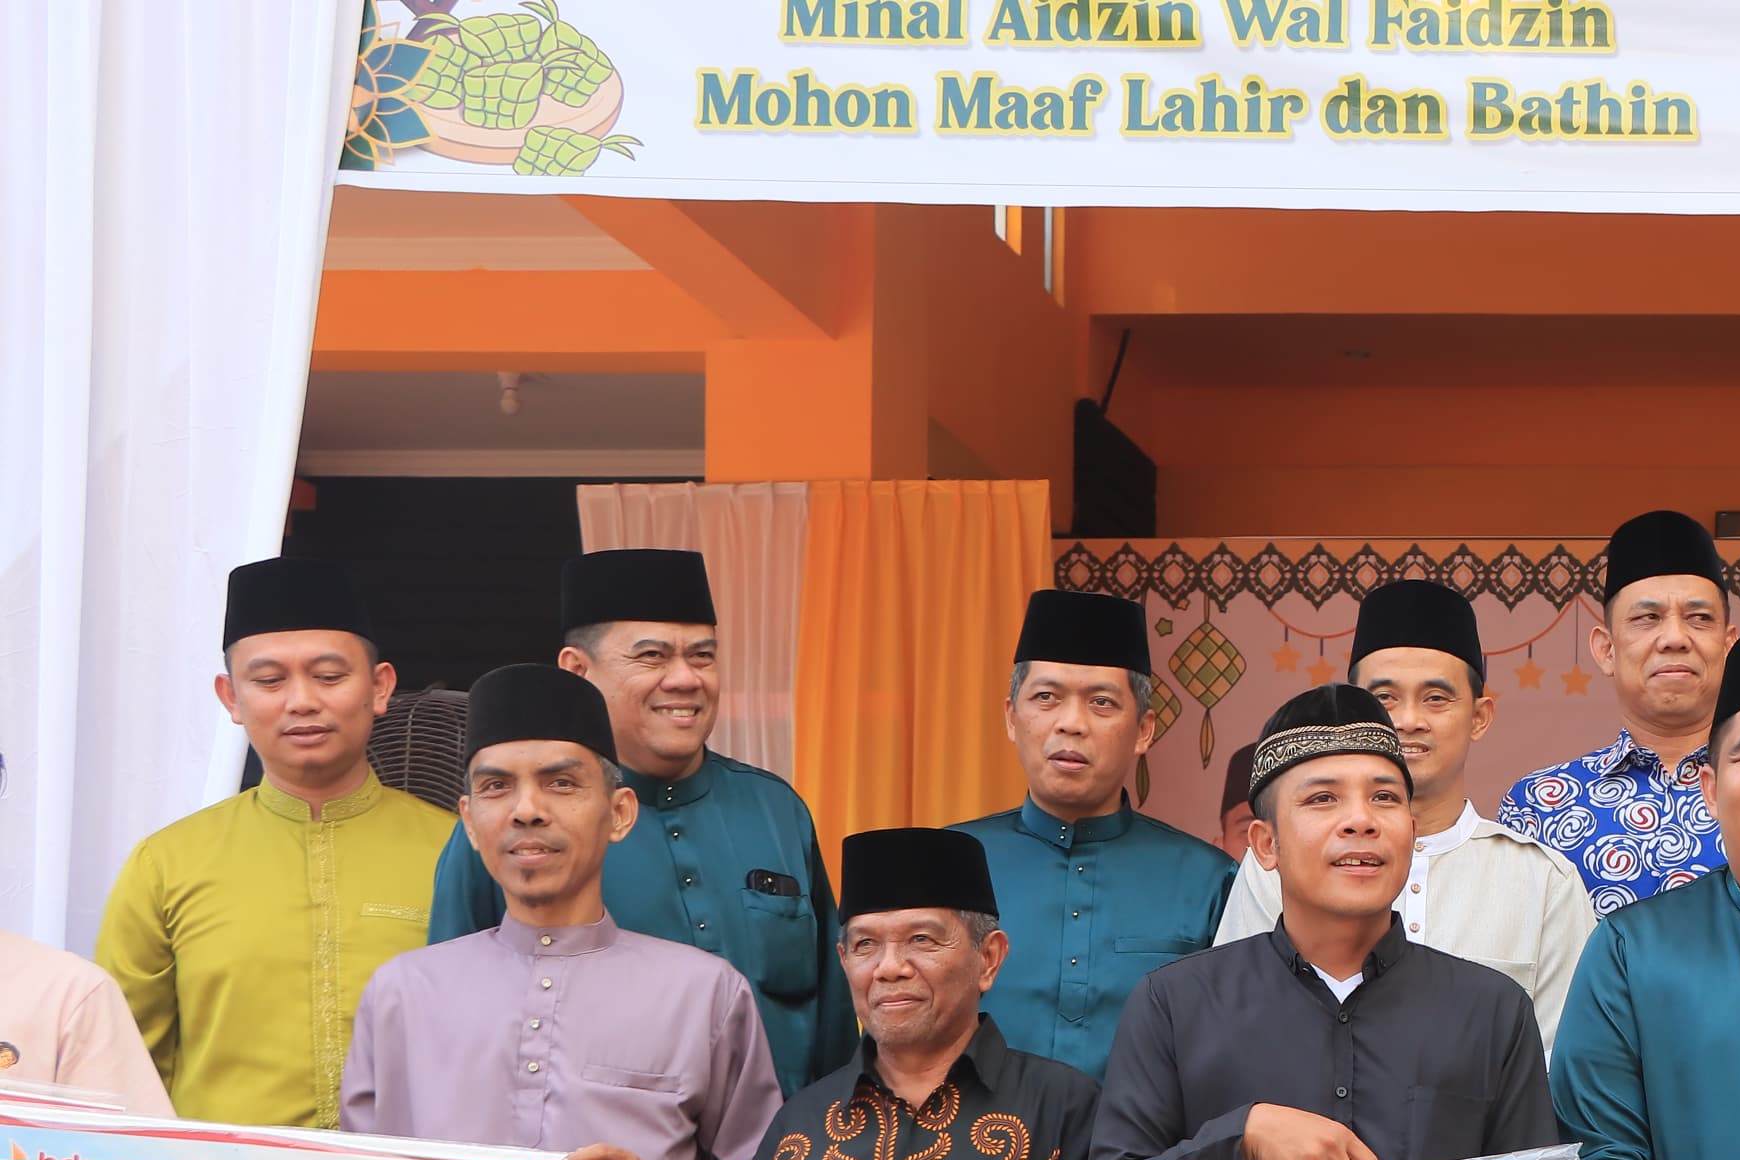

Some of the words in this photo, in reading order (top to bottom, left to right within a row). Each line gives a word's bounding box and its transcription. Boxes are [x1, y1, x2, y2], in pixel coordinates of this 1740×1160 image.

[783, 0, 963, 40] Minal
[987, 0, 1198, 42] Aidzin
[1225, 0, 1345, 44] Wal
[1371, 0, 1610, 48] Faidzin
[700, 73, 912, 129] Mohon
[939, 76, 1104, 130] Maaf
[1125, 79, 1304, 134] Lahir
[1325, 80, 1445, 134] dan
[1470, 81, 1694, 136] Bathin
